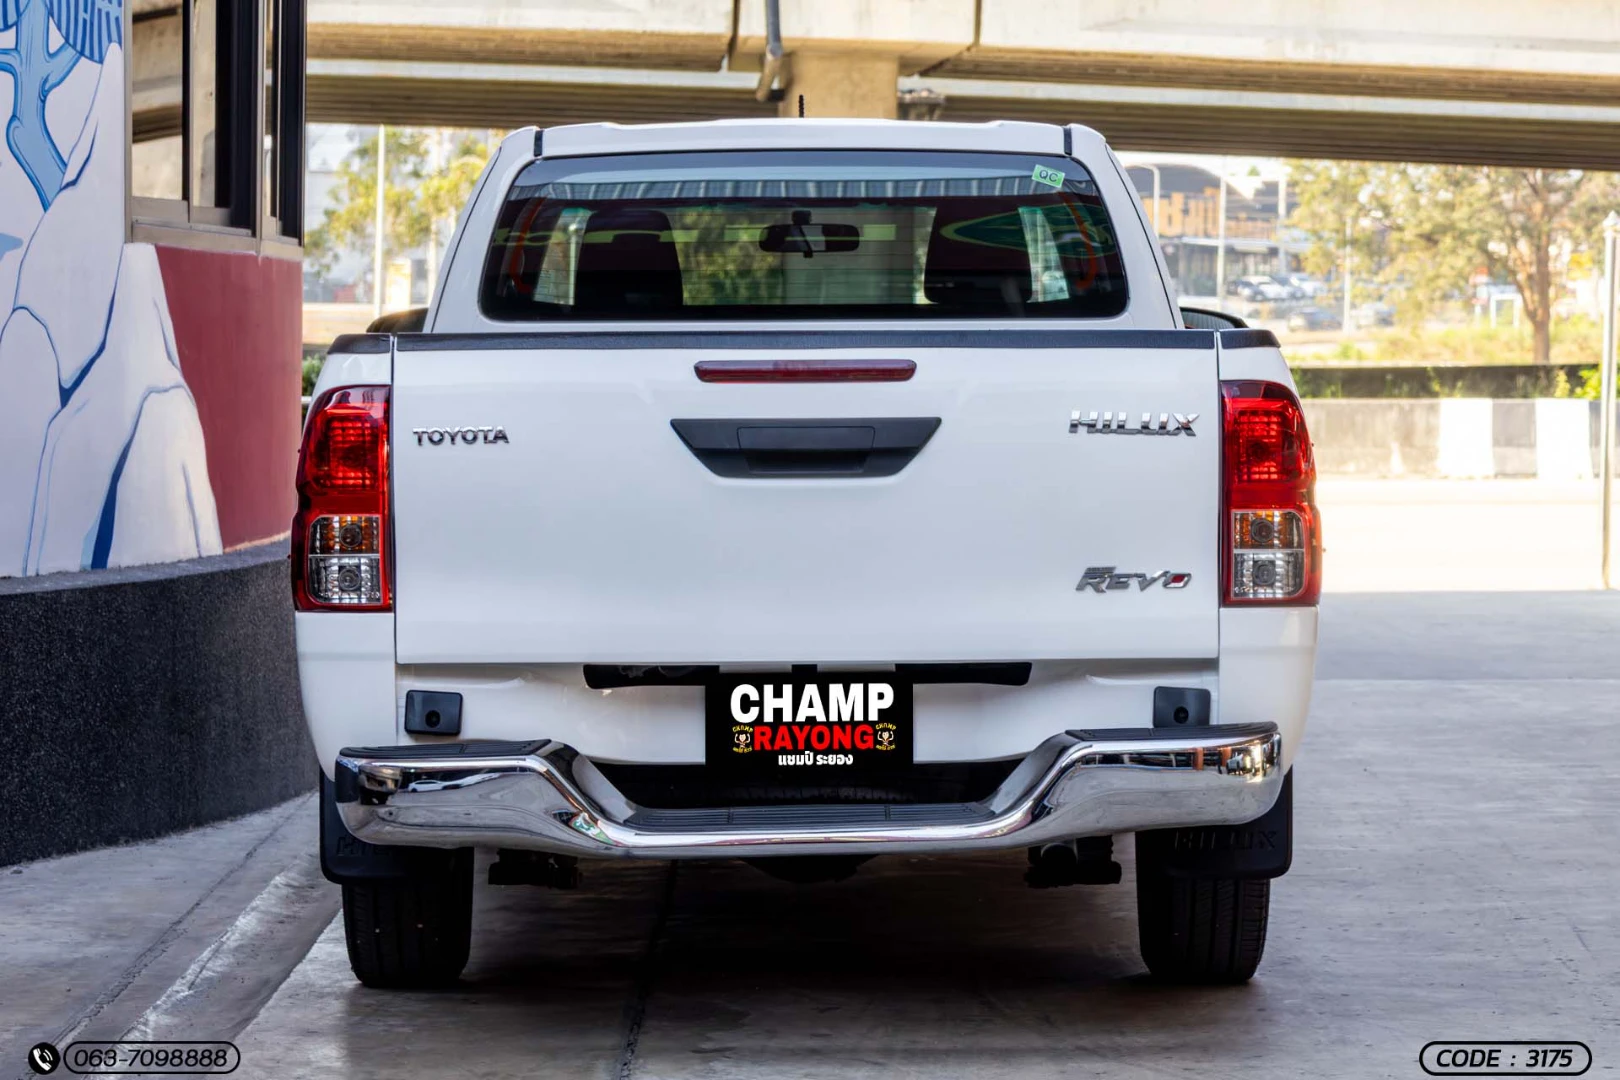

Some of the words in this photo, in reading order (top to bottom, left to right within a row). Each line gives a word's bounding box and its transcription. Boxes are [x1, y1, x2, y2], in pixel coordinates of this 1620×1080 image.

[1039, 169, 1058, 182] QC
[1069, 410, 1199, 437] HILUX
[412, 426, 510, 446] TOYOTA
